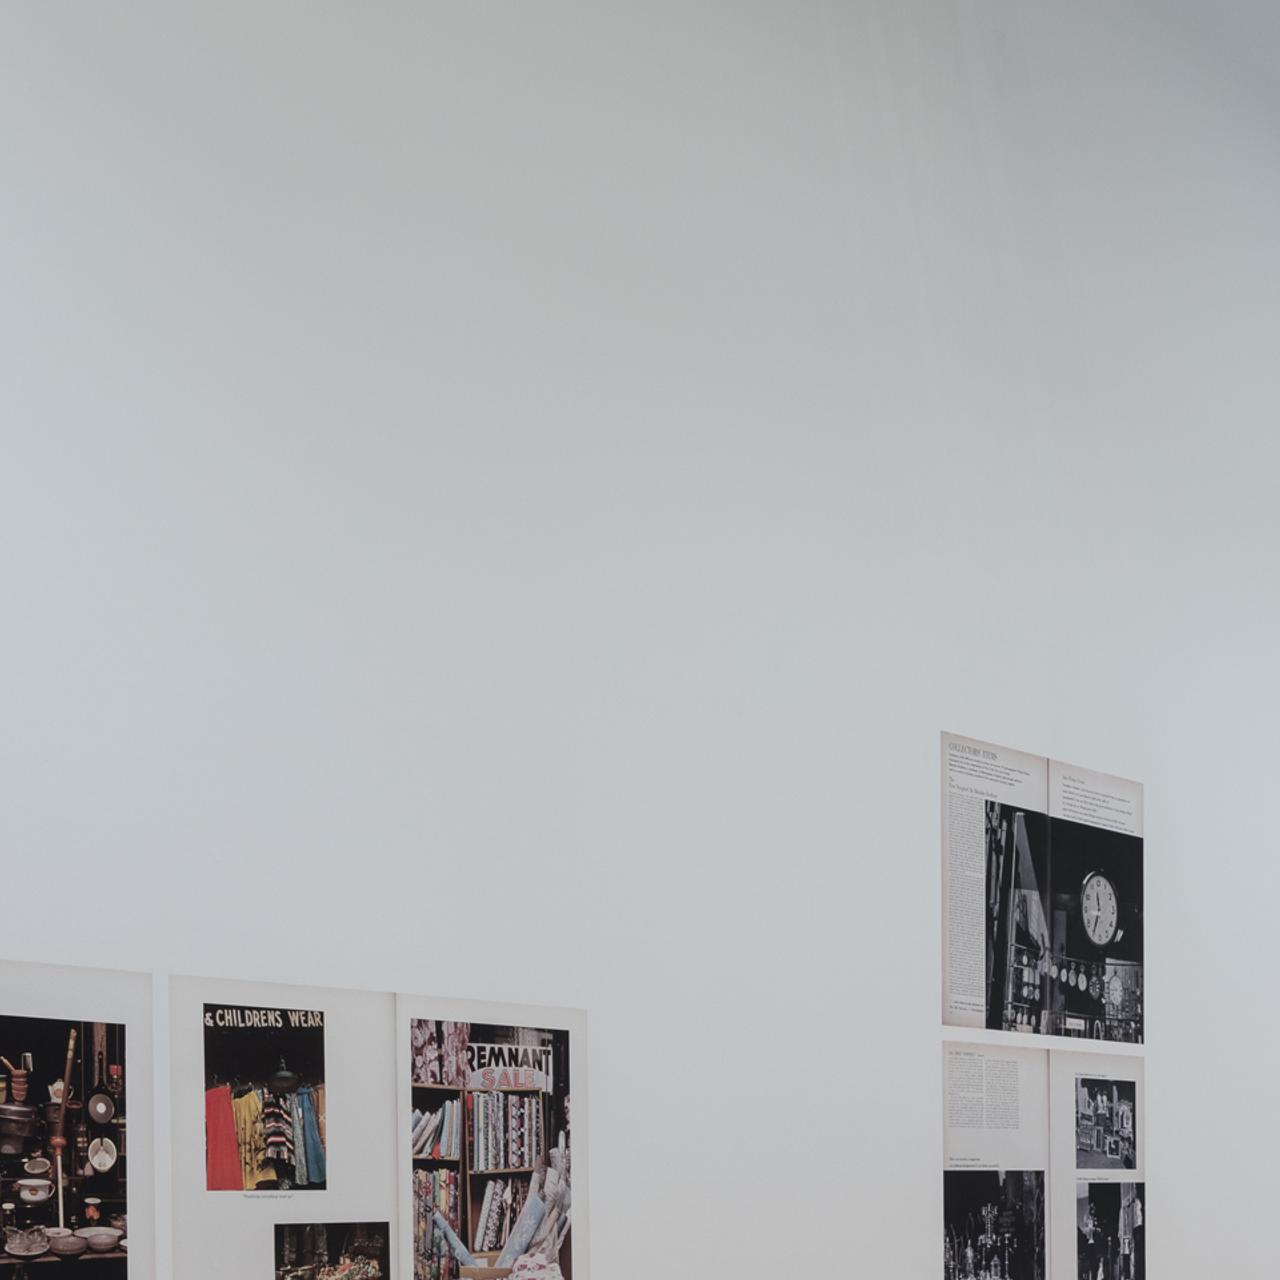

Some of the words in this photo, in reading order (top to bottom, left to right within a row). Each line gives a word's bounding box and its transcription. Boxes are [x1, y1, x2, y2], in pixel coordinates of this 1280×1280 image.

[205, 1012, 214, 1026] &
[216, 1010, 283, 1028] CHILDRENS
[288, 1010, 323, 1027] WEAR
[466, 1045, 551, 1076] REMNANT
[482, 1068, 535, 1088] SALE
